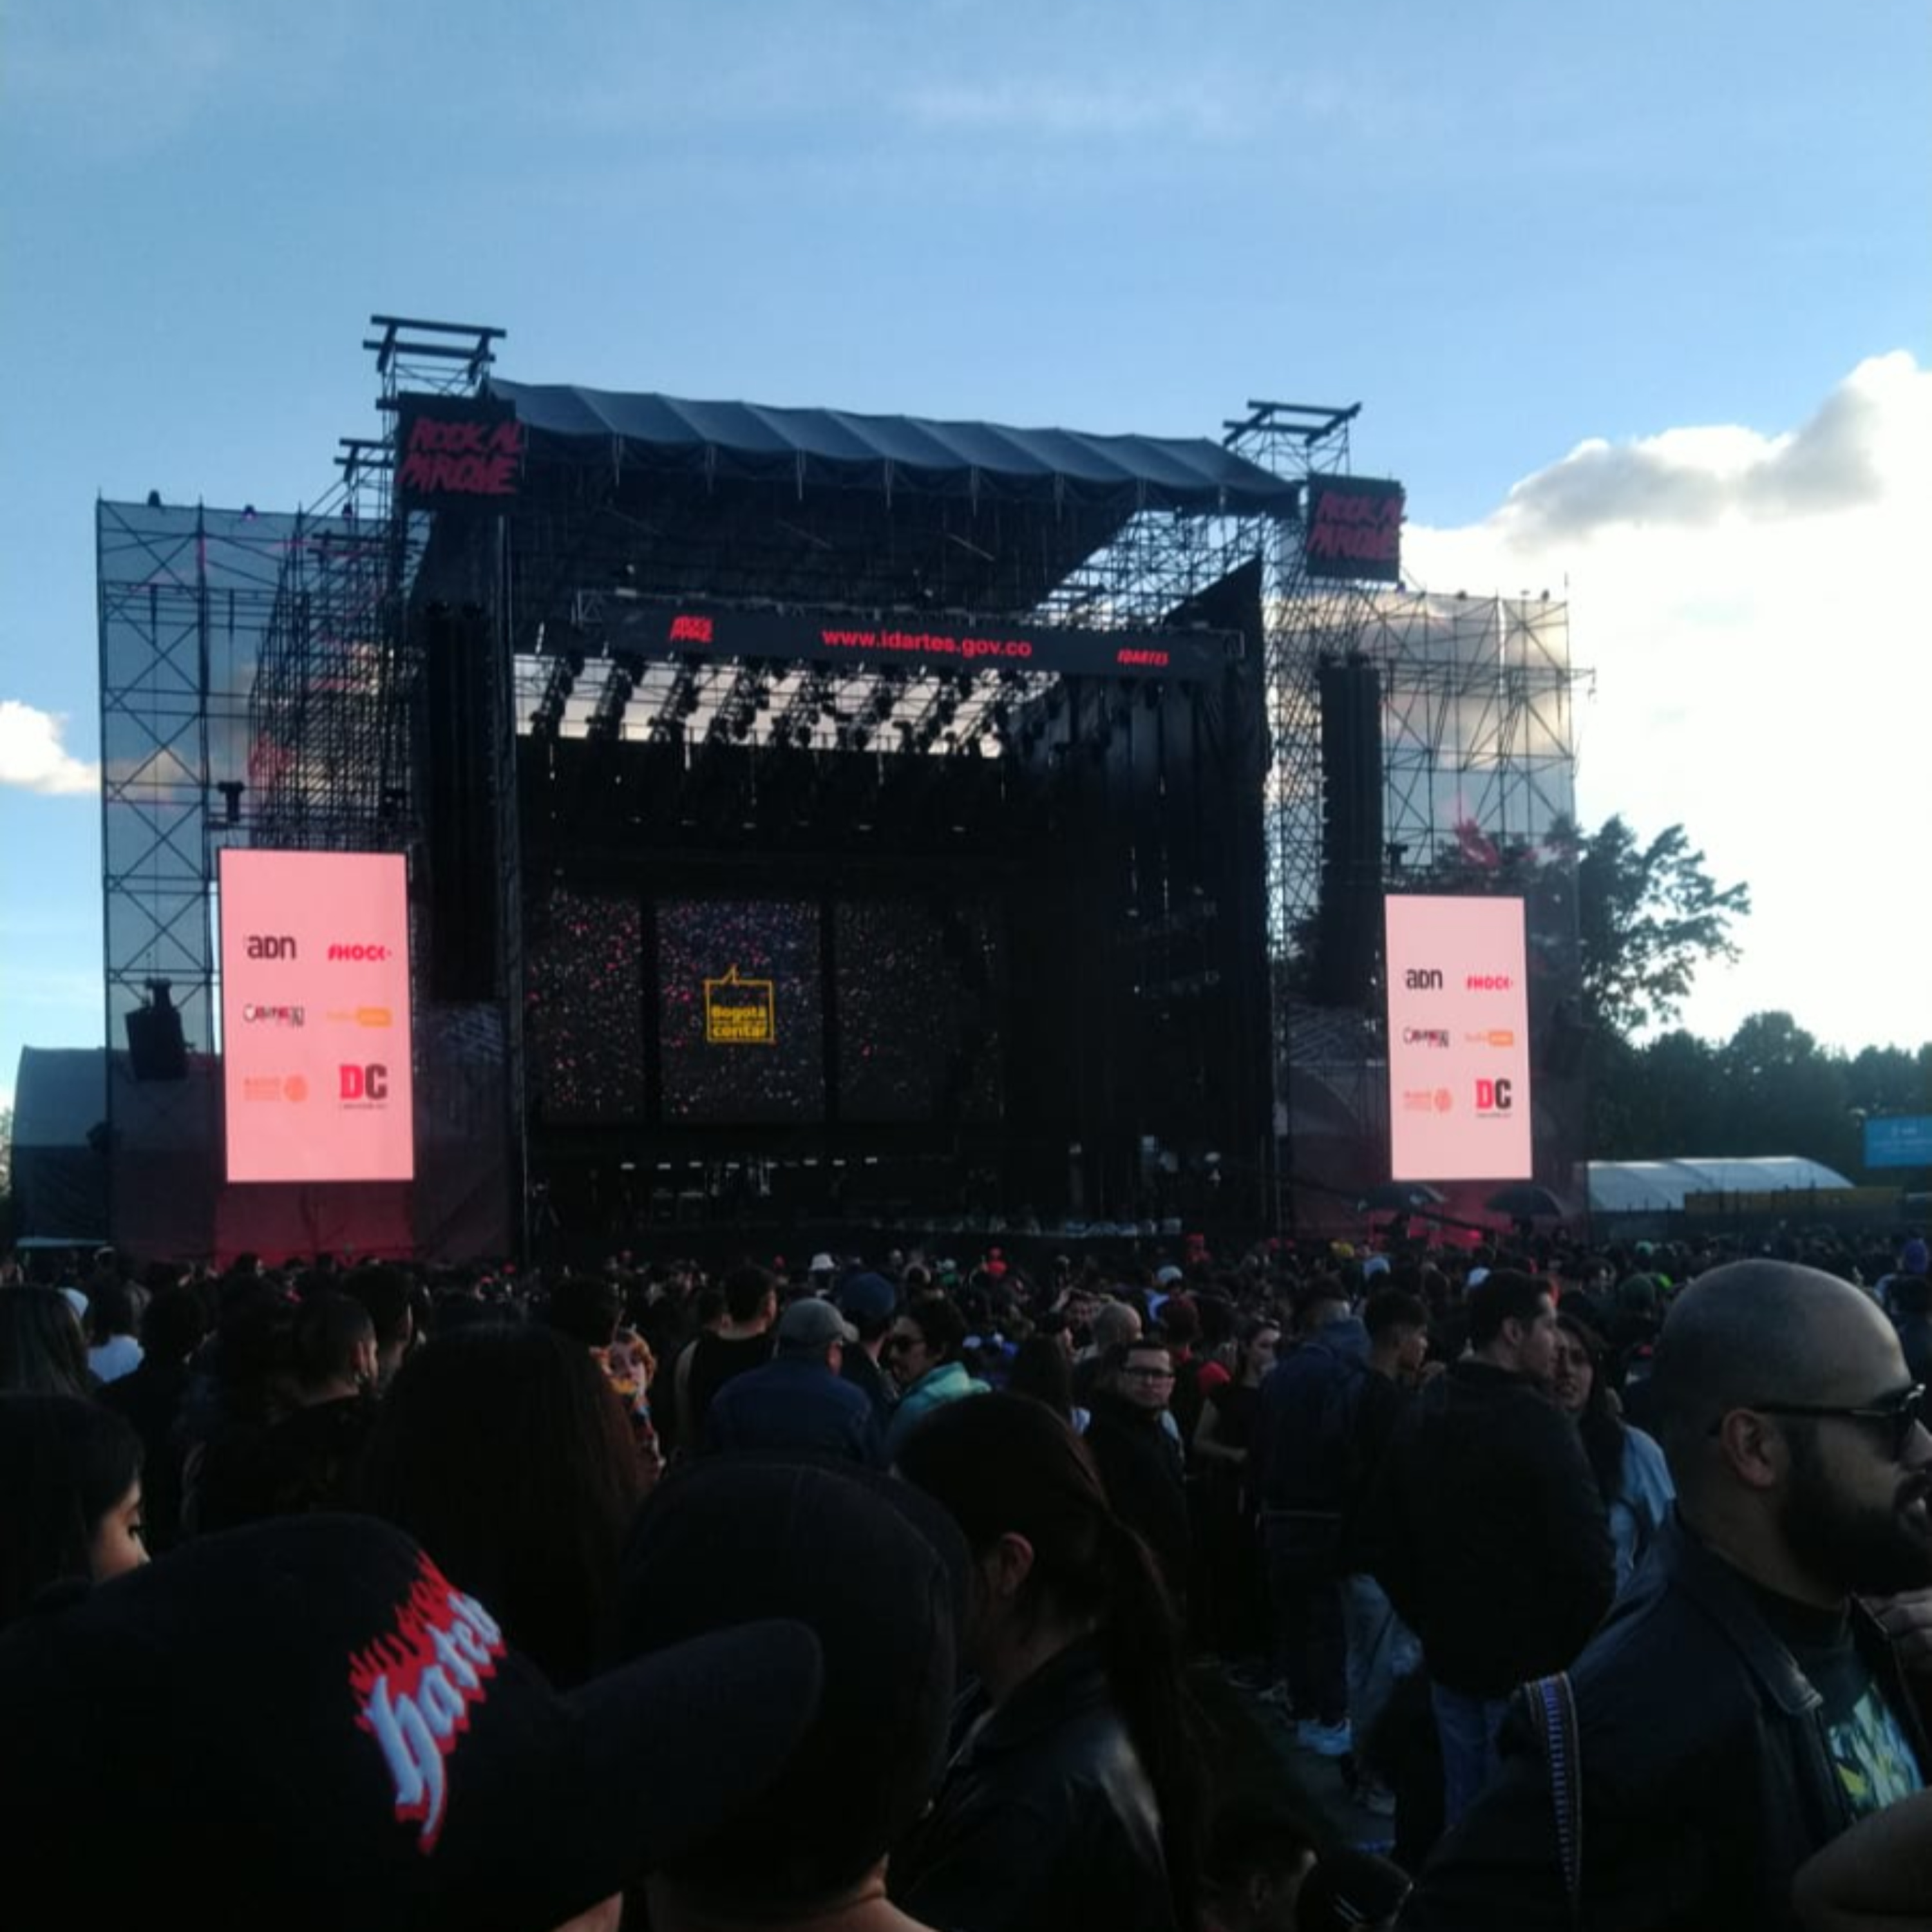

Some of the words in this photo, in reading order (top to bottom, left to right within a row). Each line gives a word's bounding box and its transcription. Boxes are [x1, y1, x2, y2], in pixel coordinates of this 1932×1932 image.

[822, 629, 1032, 658] www.idartes.gov.co
[339, 1064, 387, 1101] DC
[1477, 1079, 1511, 1110] DC
